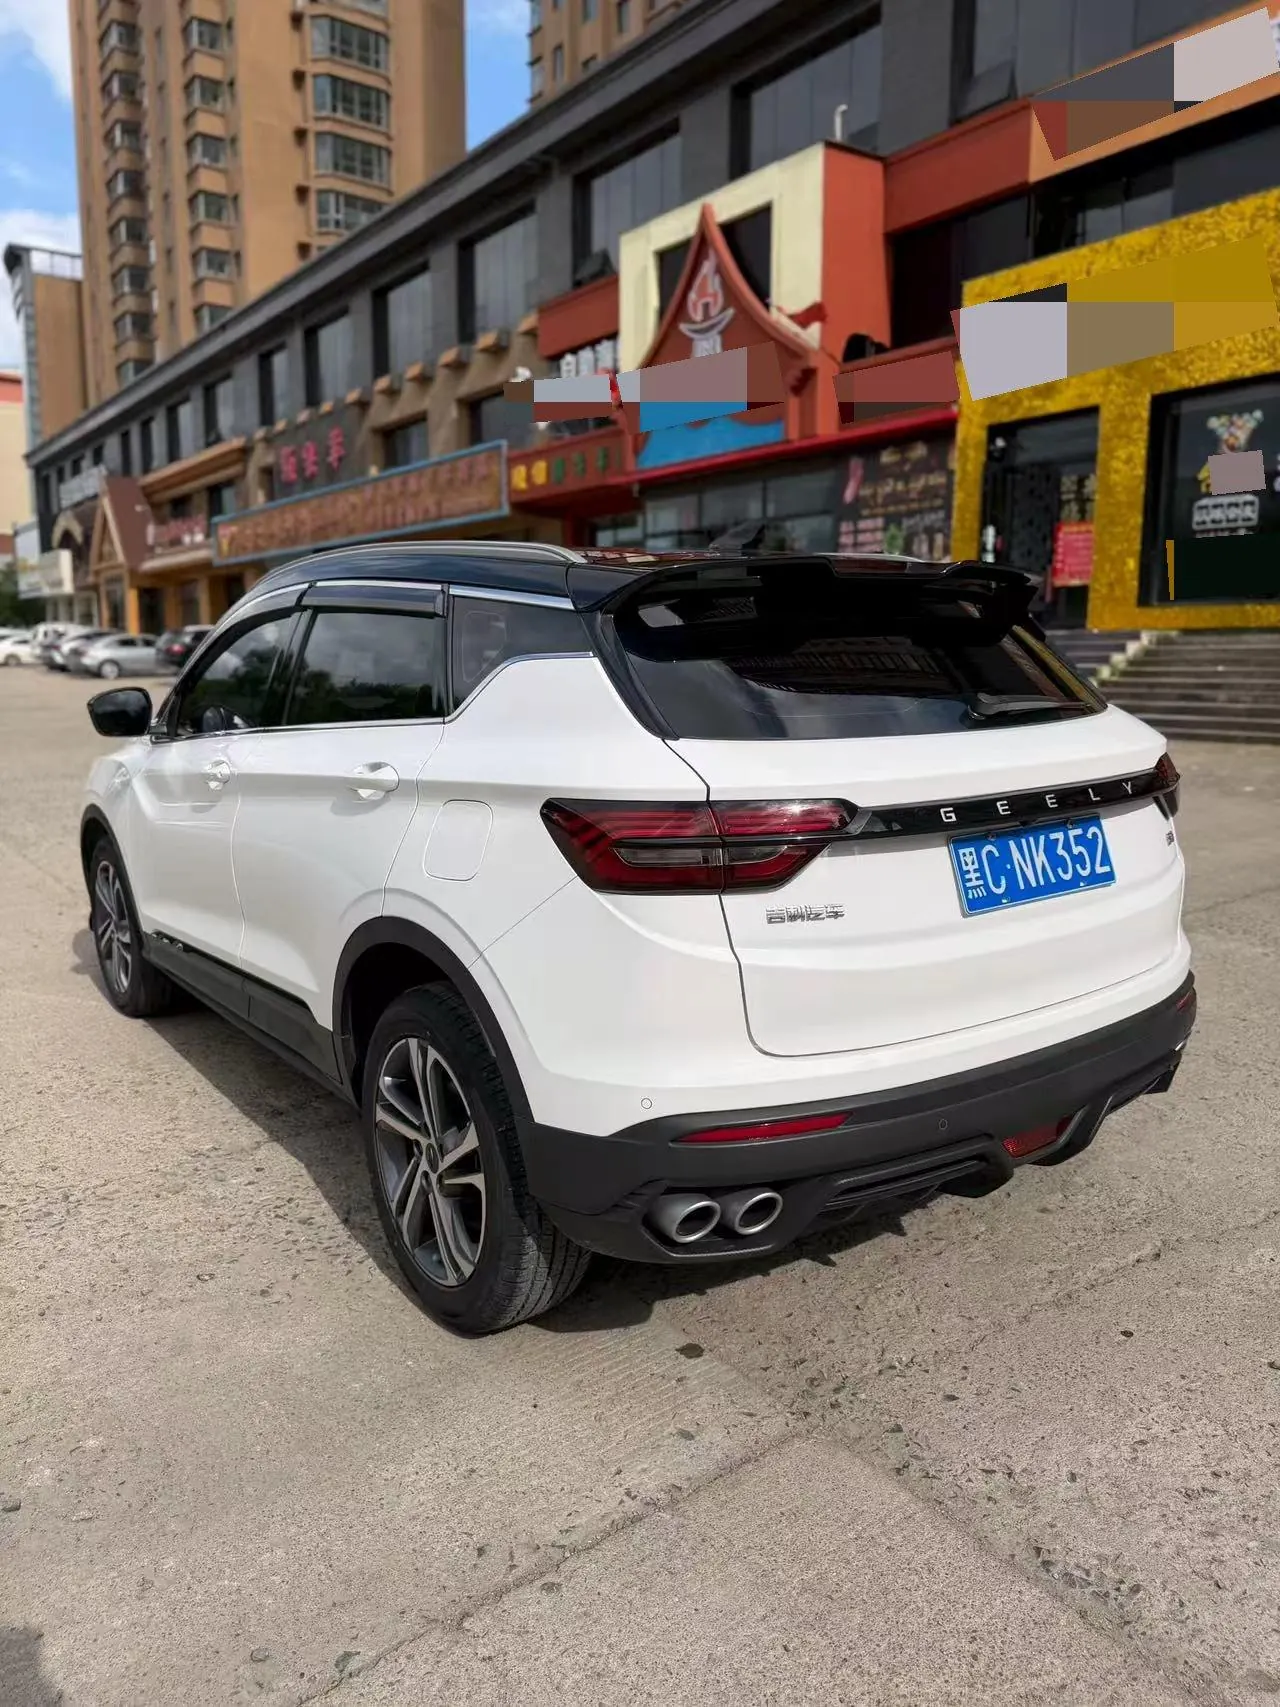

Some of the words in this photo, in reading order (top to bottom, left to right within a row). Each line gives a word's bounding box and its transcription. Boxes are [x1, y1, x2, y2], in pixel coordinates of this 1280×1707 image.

[940, 783, 1134, 822] GEELY
[766, 904, 846, 925] 吉利汽车
